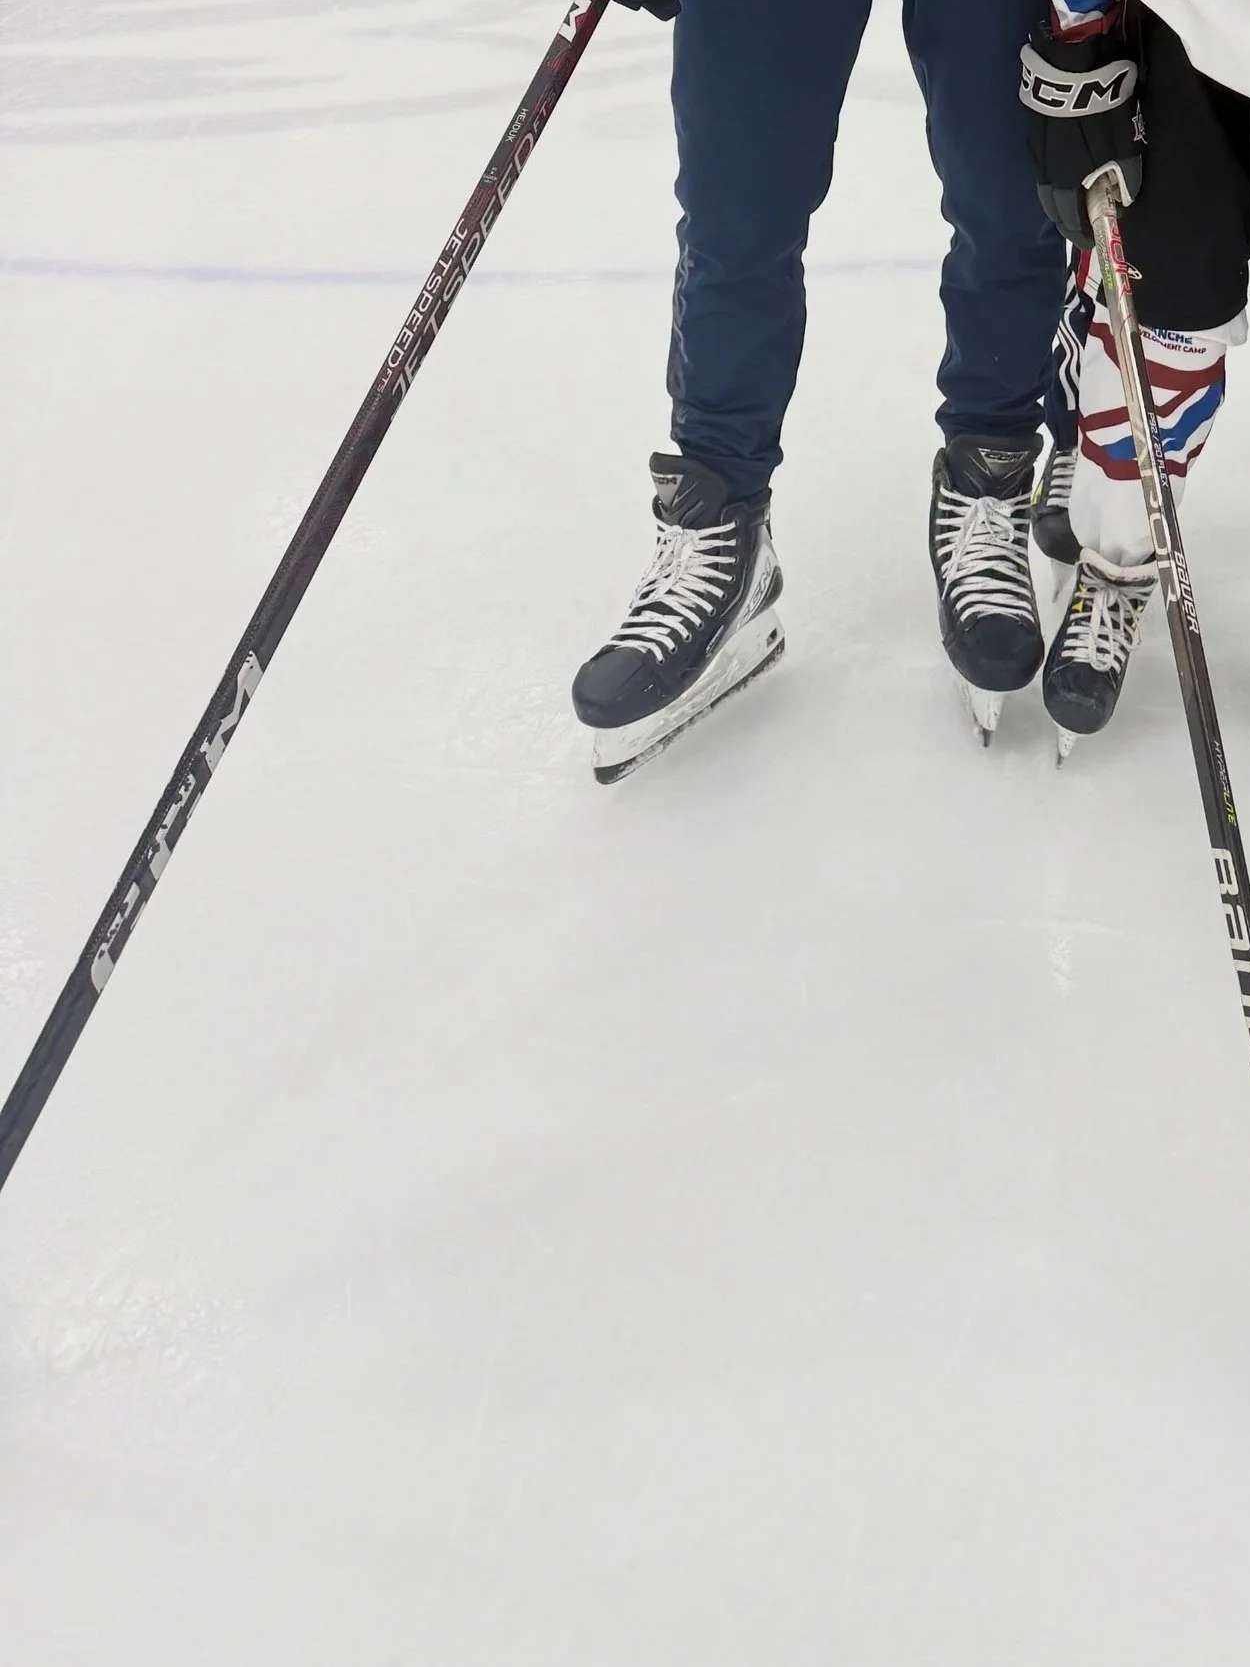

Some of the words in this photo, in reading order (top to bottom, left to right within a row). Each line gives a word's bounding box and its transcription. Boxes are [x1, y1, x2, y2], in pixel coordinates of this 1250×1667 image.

[1020, 65, 1130, 112] CCM
[505, 108, 528, 142] HEJDUK
[388, 218, 468, 368] JETSPEED
[1182, 345, 1207, 355] CAMP
[377, 368, 393, 394] FTS
[1157, 459, 1169, 488] FLEX
[1172, 549, 1201, 634] BAUER
[1213, 739, 1238, 828] HYPERLITE
